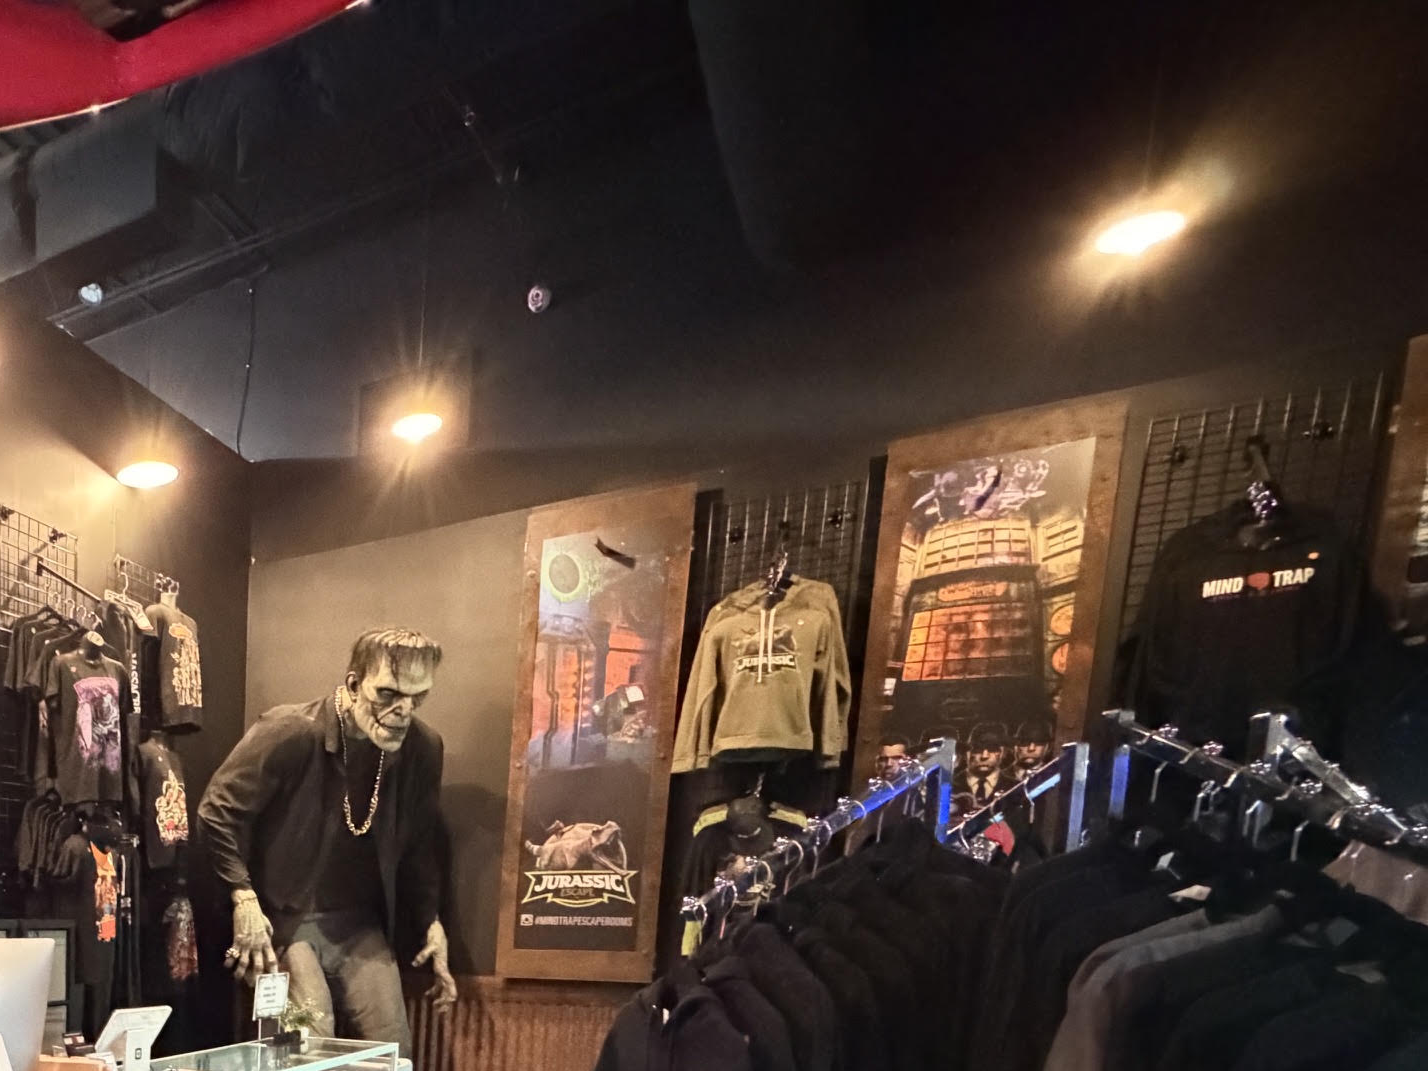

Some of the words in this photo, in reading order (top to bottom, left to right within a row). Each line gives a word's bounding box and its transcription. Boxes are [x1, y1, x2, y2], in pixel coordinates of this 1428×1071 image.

[1202, 577, 1244, 598] MIND
[1272, 567, 1314, 587] TRAP
[534, 874, 625, 893] JURASSIC
